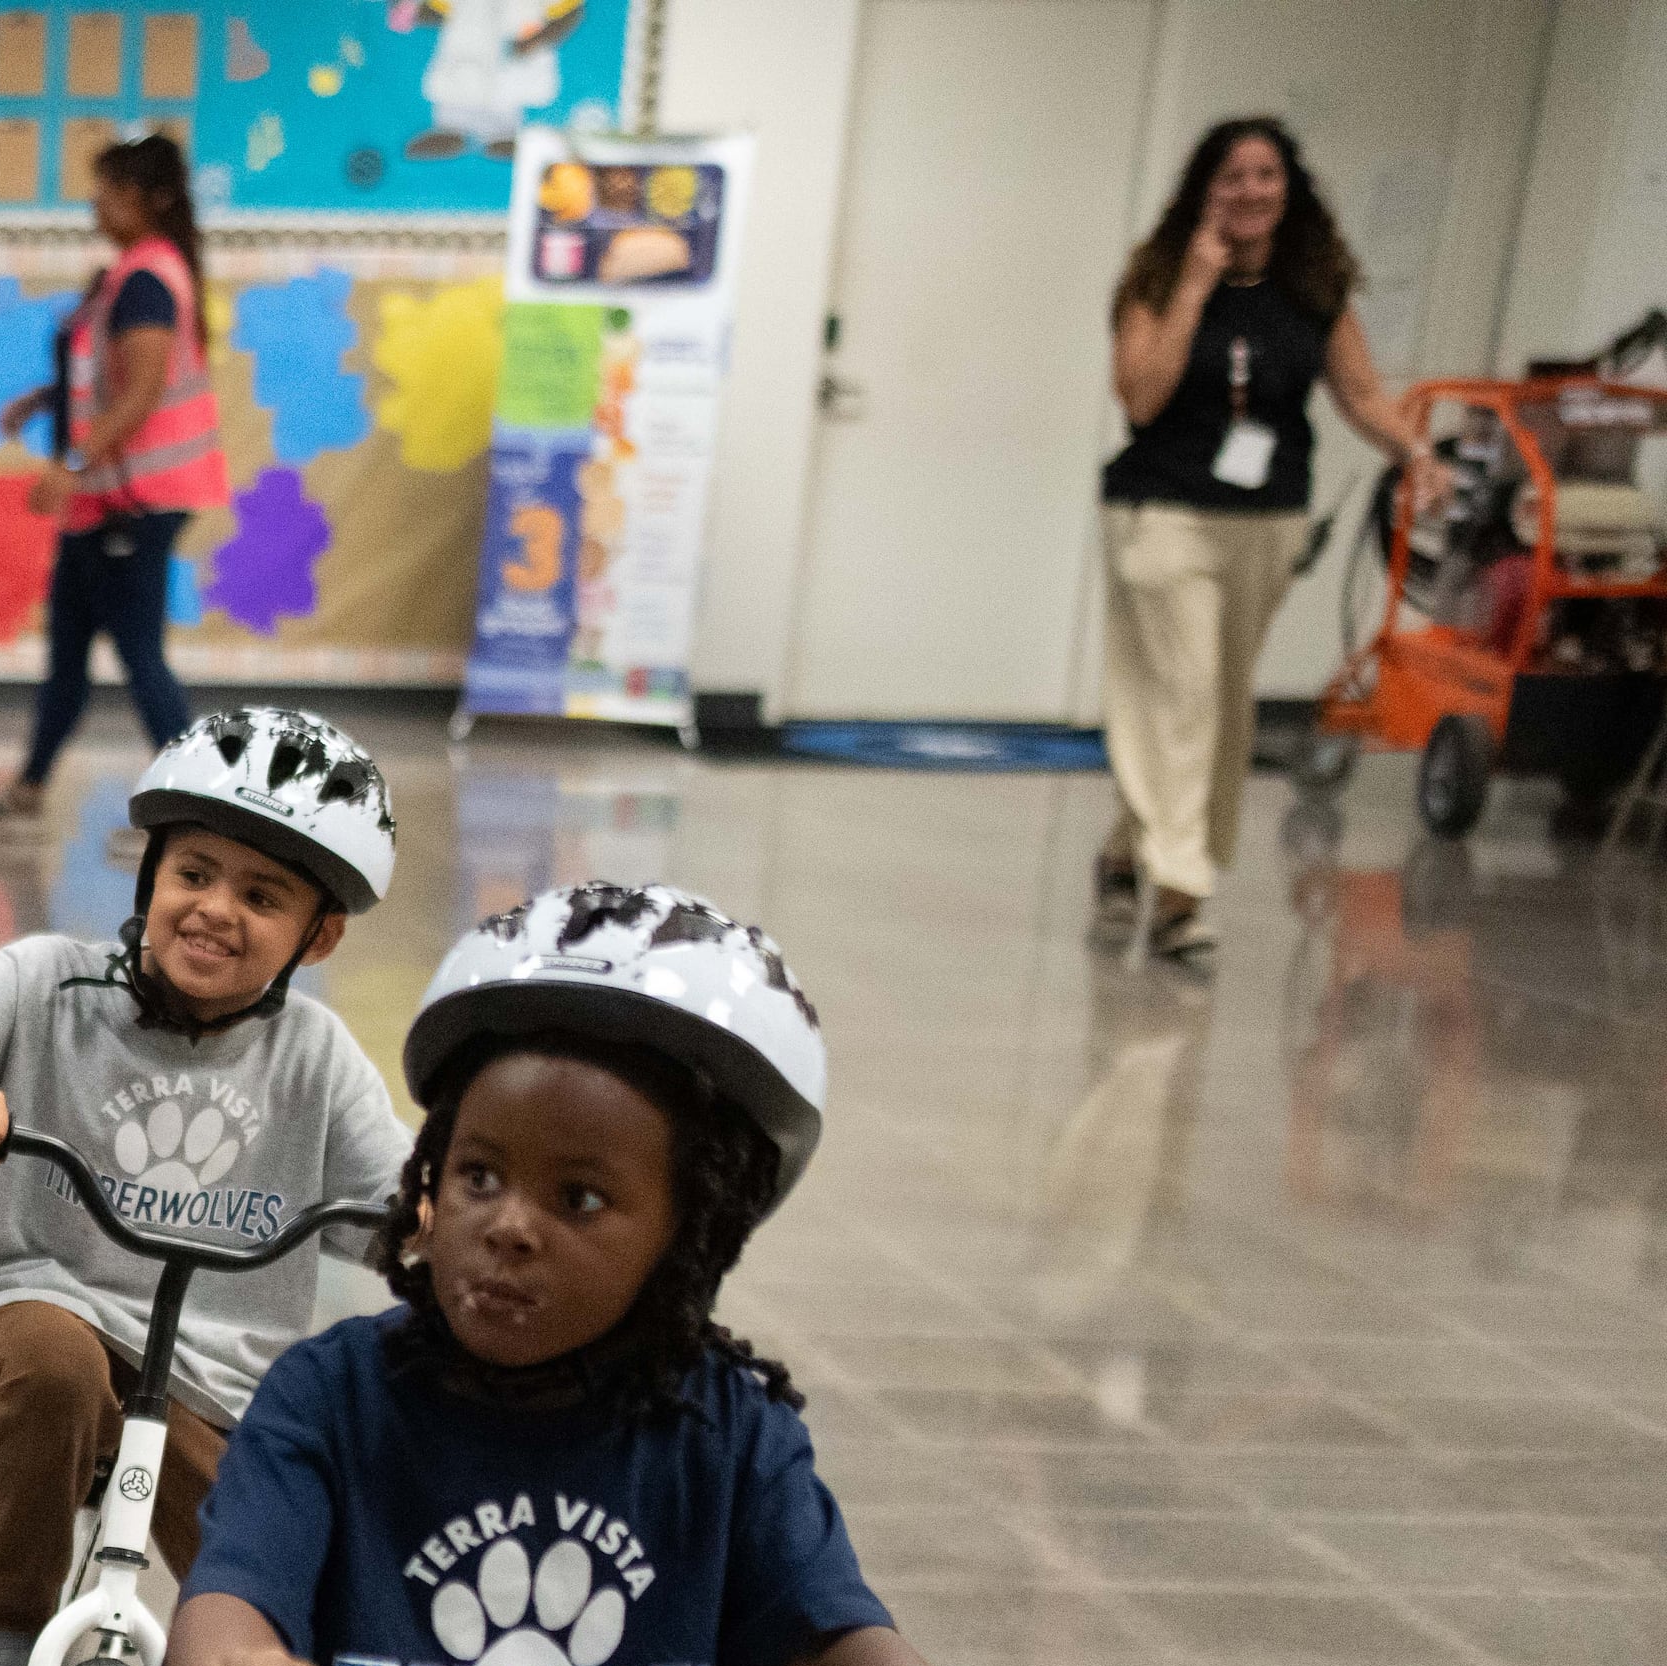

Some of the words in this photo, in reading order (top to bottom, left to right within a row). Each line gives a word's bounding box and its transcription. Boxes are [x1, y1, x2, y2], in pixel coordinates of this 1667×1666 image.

[502, 506, 563, 592] 3
[101, 1073, 194, 1122] TERRA
[210, 1077, 262, 1146] VISTA
[403, 1491, 537, 1588] TERRA
[554, 1492, 657, 1602] VISTA
